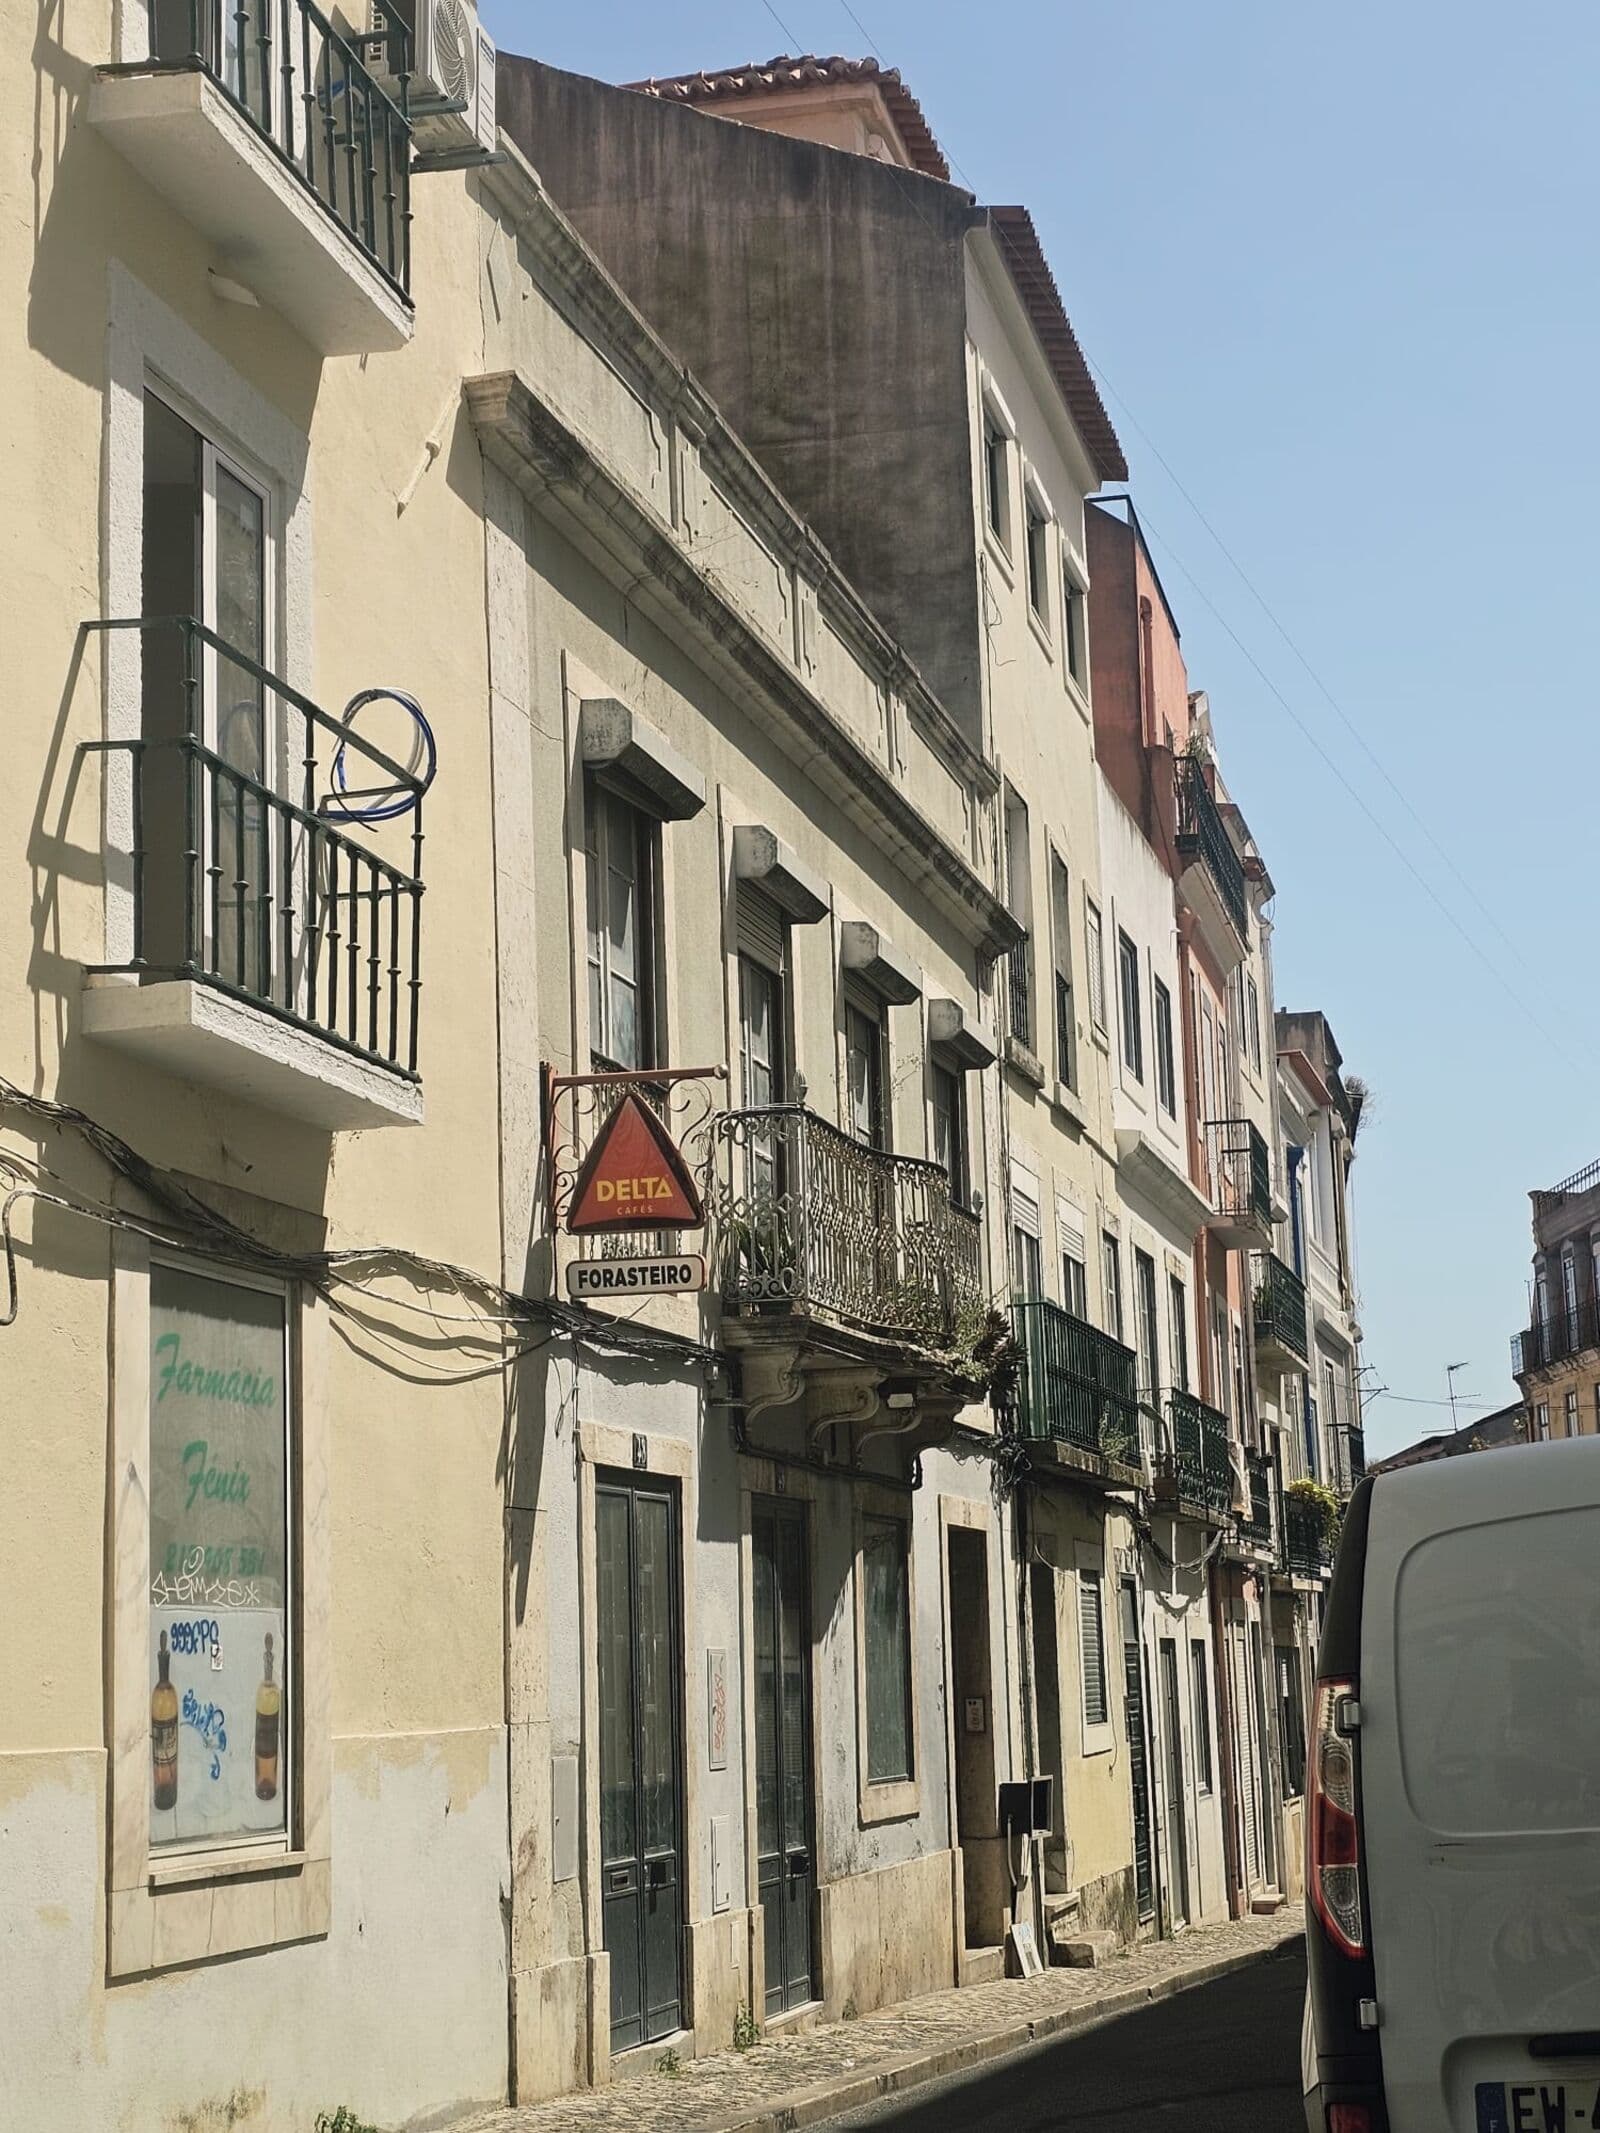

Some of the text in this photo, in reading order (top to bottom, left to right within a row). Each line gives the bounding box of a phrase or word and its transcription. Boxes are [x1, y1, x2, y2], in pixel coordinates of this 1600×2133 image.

[596, 1176, 673, 1202] DELTA
[616, 1204, 653, 1216] CAFÉS
[578, 1264, 692, 1289] FORASTEIRO
[155, 1333, 276, 1408] Farmácia
[182, 1440, 250, 1510] Fénix
